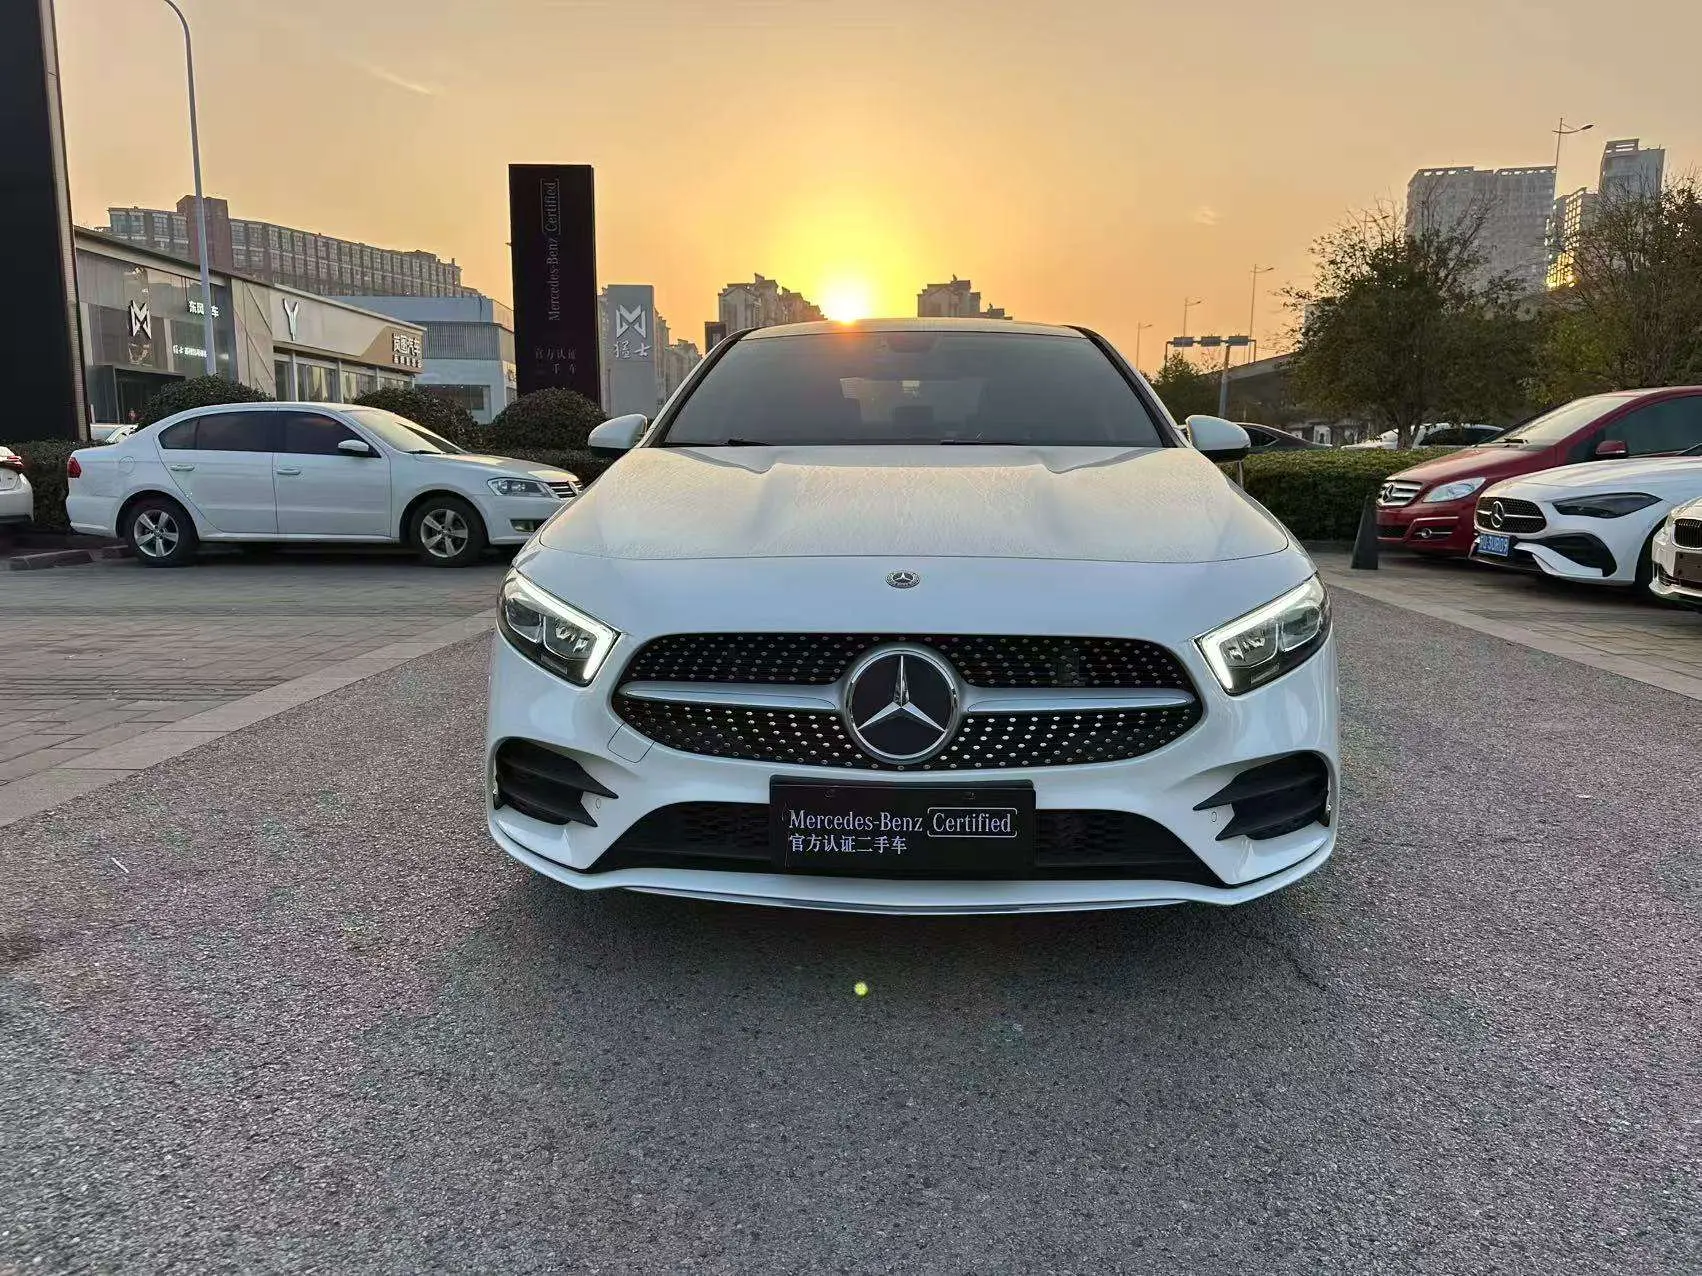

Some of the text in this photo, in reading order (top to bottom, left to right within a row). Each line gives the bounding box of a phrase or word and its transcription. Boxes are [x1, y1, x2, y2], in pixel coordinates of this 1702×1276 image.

[544, 182, 560, 321] Mercedes-Benz Certified
[189, 300, 219, 318] 东风车
[789, 809, 1012, 833] Mercedes-Benz Certified
[789, 833, 907, 855] 官方认证二手车
